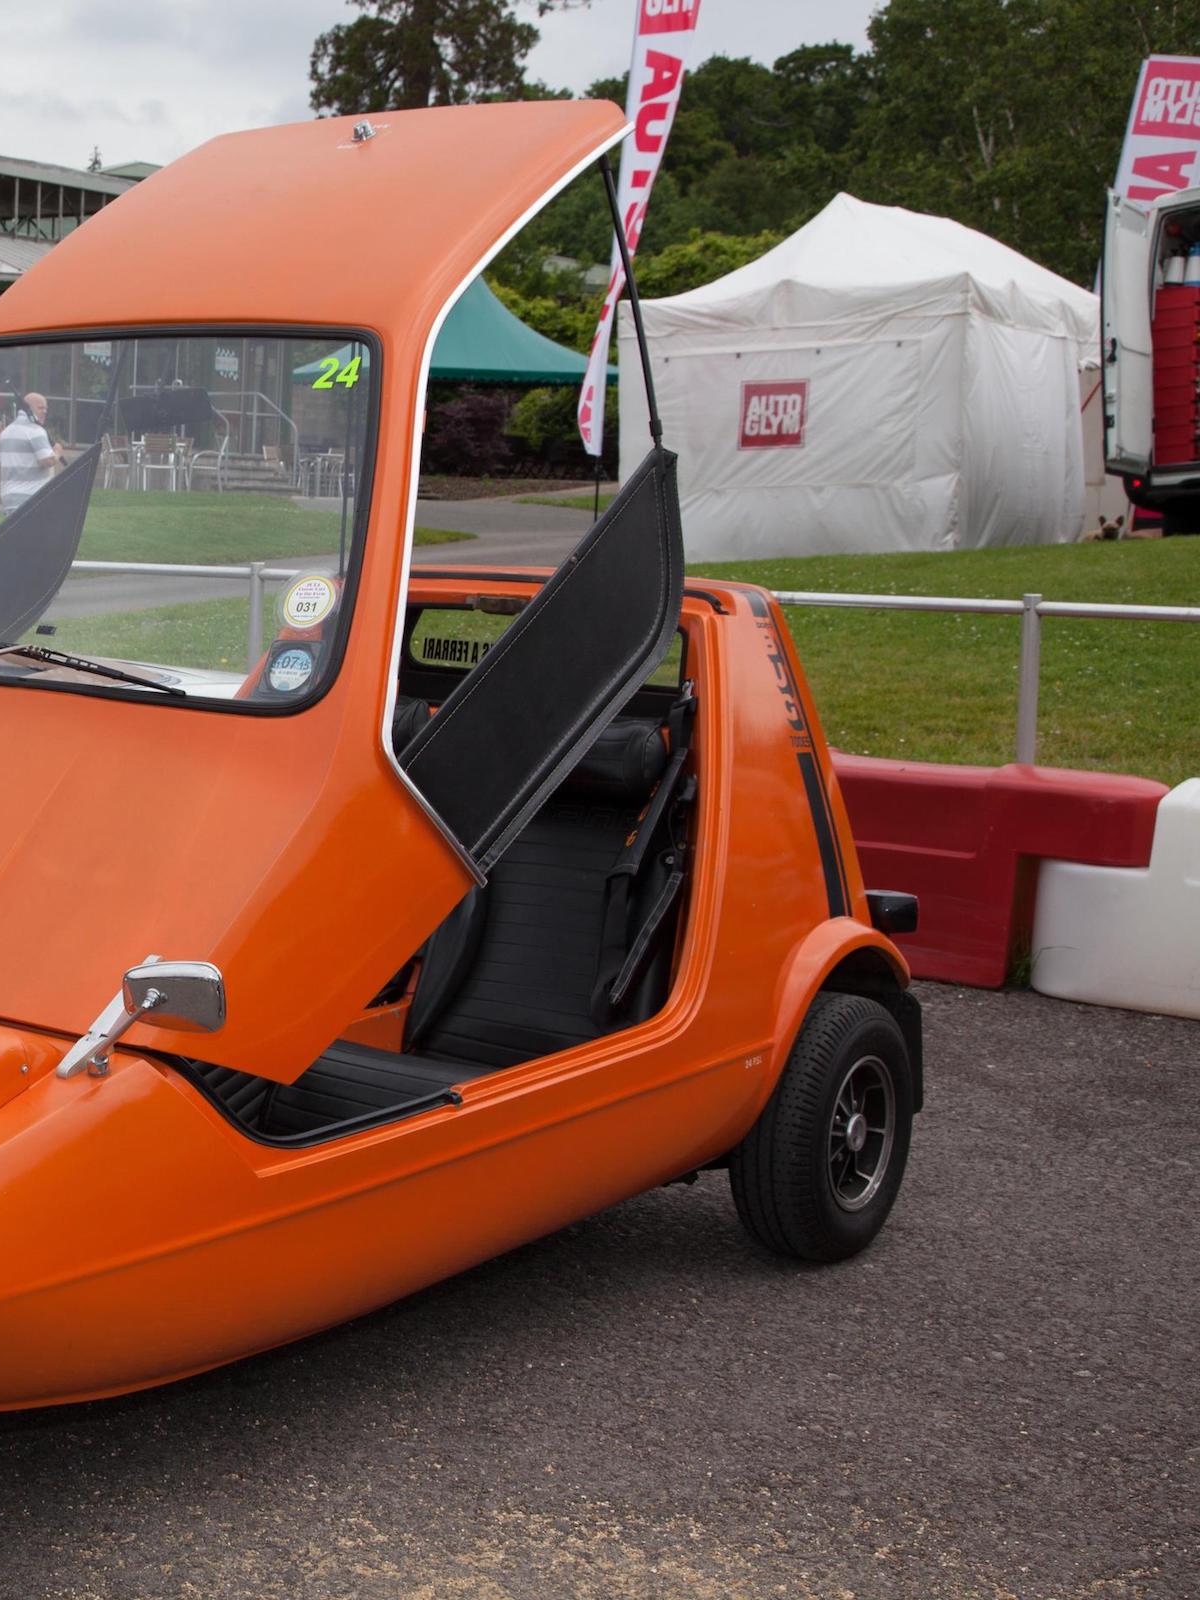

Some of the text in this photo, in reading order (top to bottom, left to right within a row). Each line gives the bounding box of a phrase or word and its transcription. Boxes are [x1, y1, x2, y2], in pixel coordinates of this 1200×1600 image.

[311, 356, 362, 389] 24
[747, 394, 802, 416] AUTO
[744, 412, 801, 437] GLYM
[296, 602, 317, 612] 031
